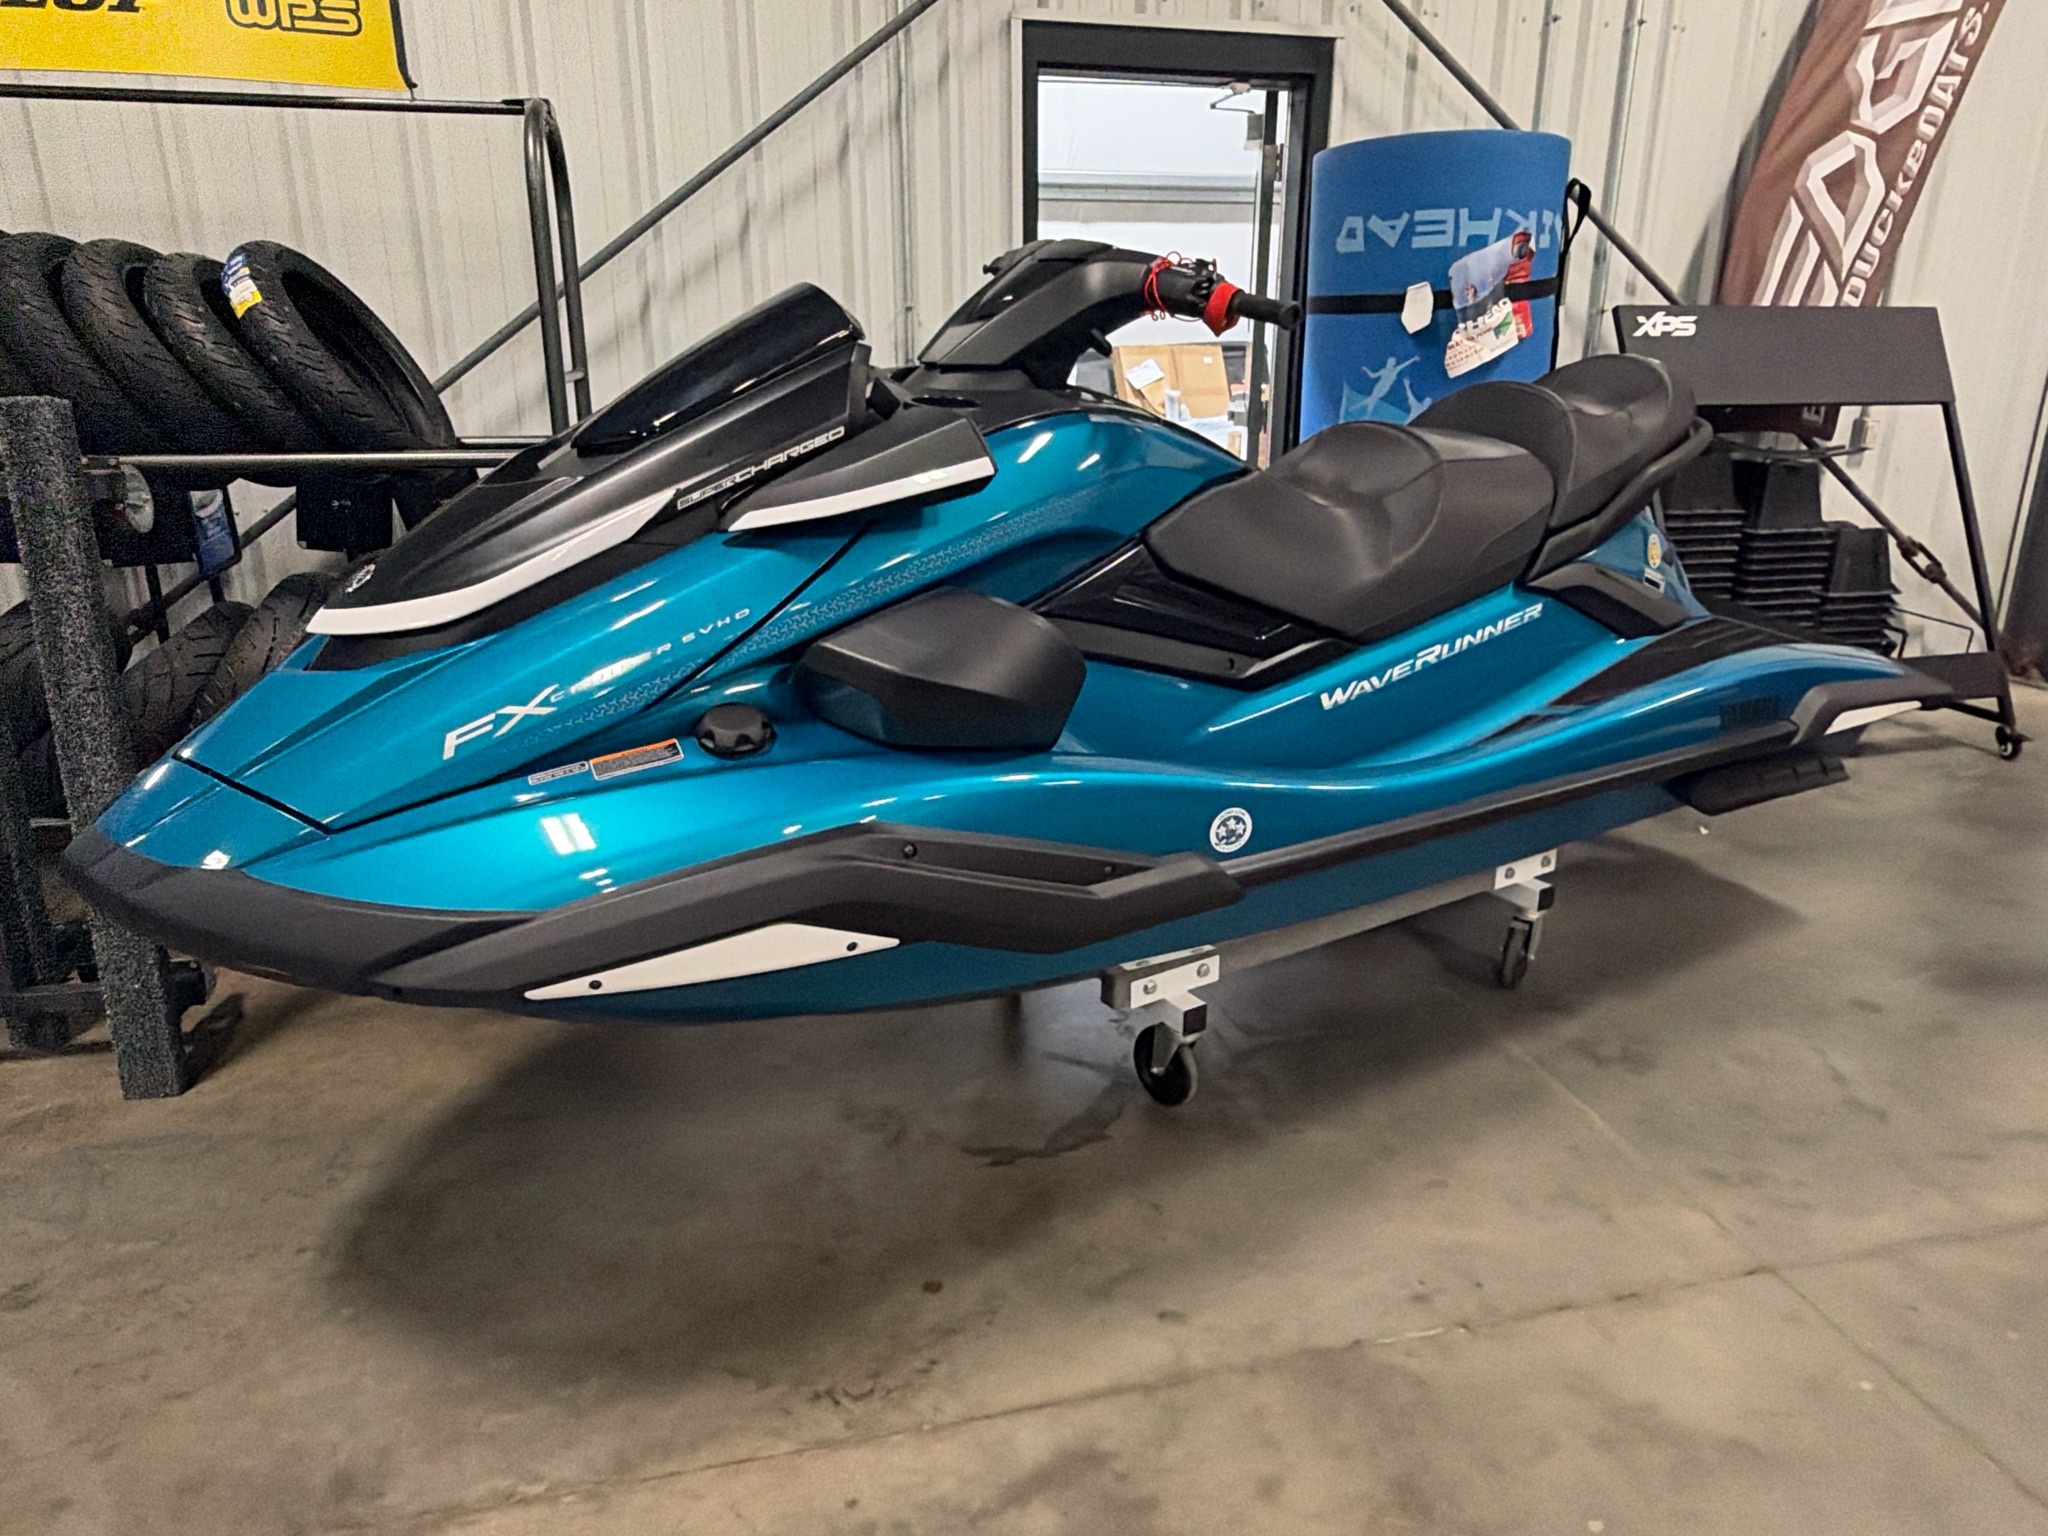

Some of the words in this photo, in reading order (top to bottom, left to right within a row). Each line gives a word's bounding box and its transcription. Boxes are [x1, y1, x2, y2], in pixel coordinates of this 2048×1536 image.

[1632, 311, 1698, 338] XPS
[677, 426, 845, 510] SUPERCHARGED
[441, 683, 560, 761] FX
[680, 606, 751, 645] SVHO
